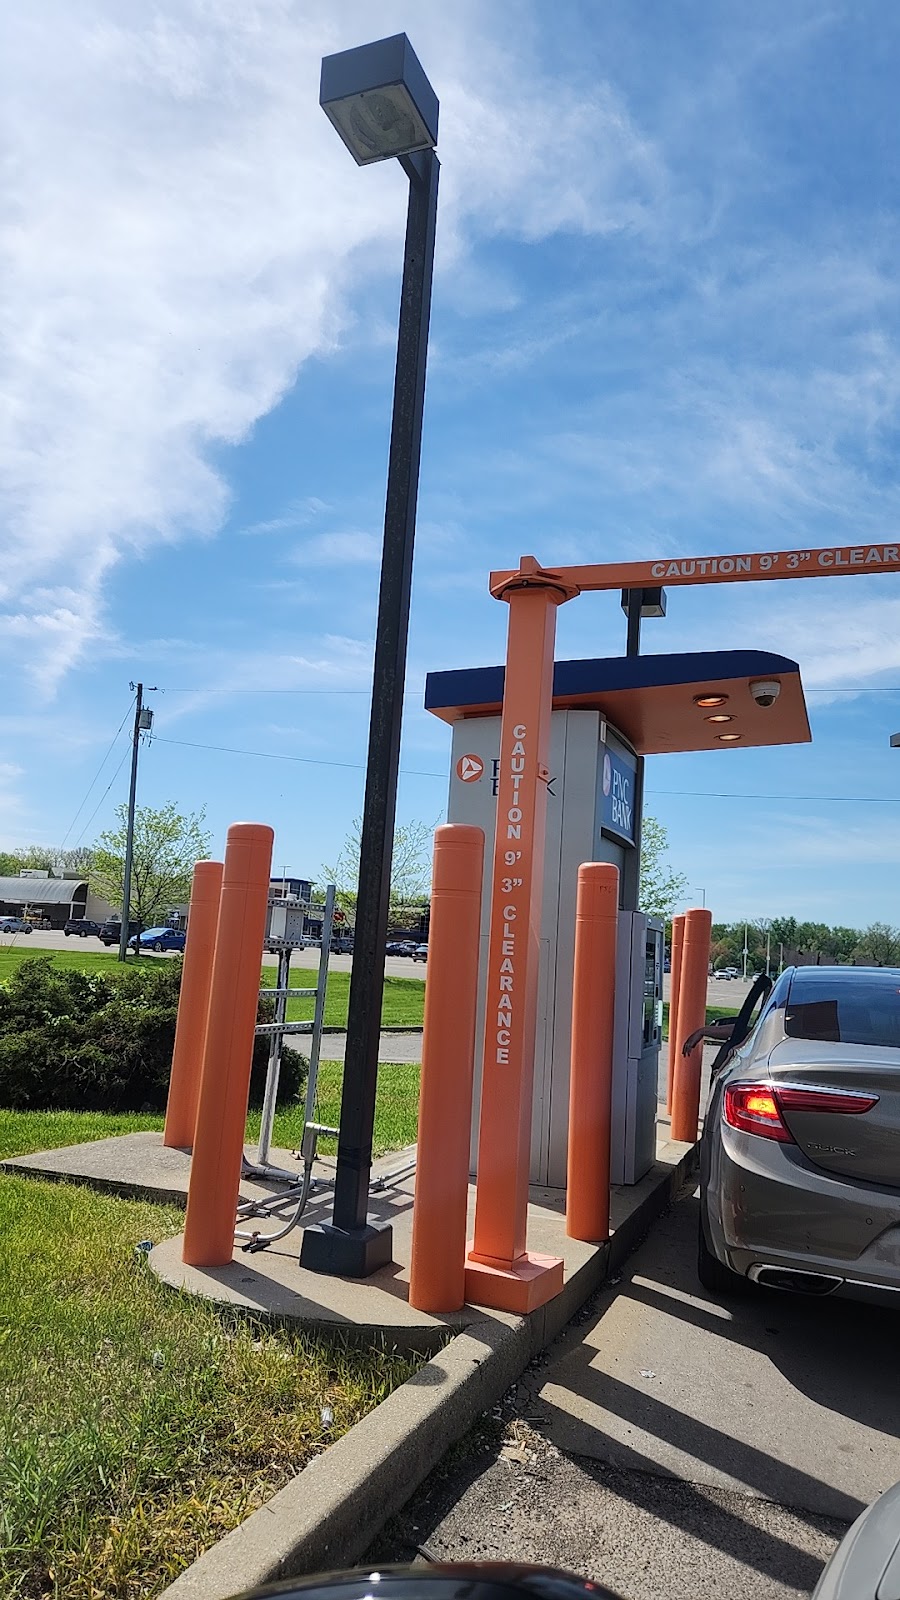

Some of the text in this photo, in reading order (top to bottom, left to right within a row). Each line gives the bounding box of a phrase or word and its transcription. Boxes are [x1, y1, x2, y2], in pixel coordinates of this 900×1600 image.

[651, 556, 751, 578] CAUTION
[818, 546, 900, 566] CLEAR
[507, 724, 526, 839] CAUTION
[612, 768, 630, 804] PNC
[611, 795, 632, 830] BANK
[496, 905, 516, 1064] CLEARANCE
